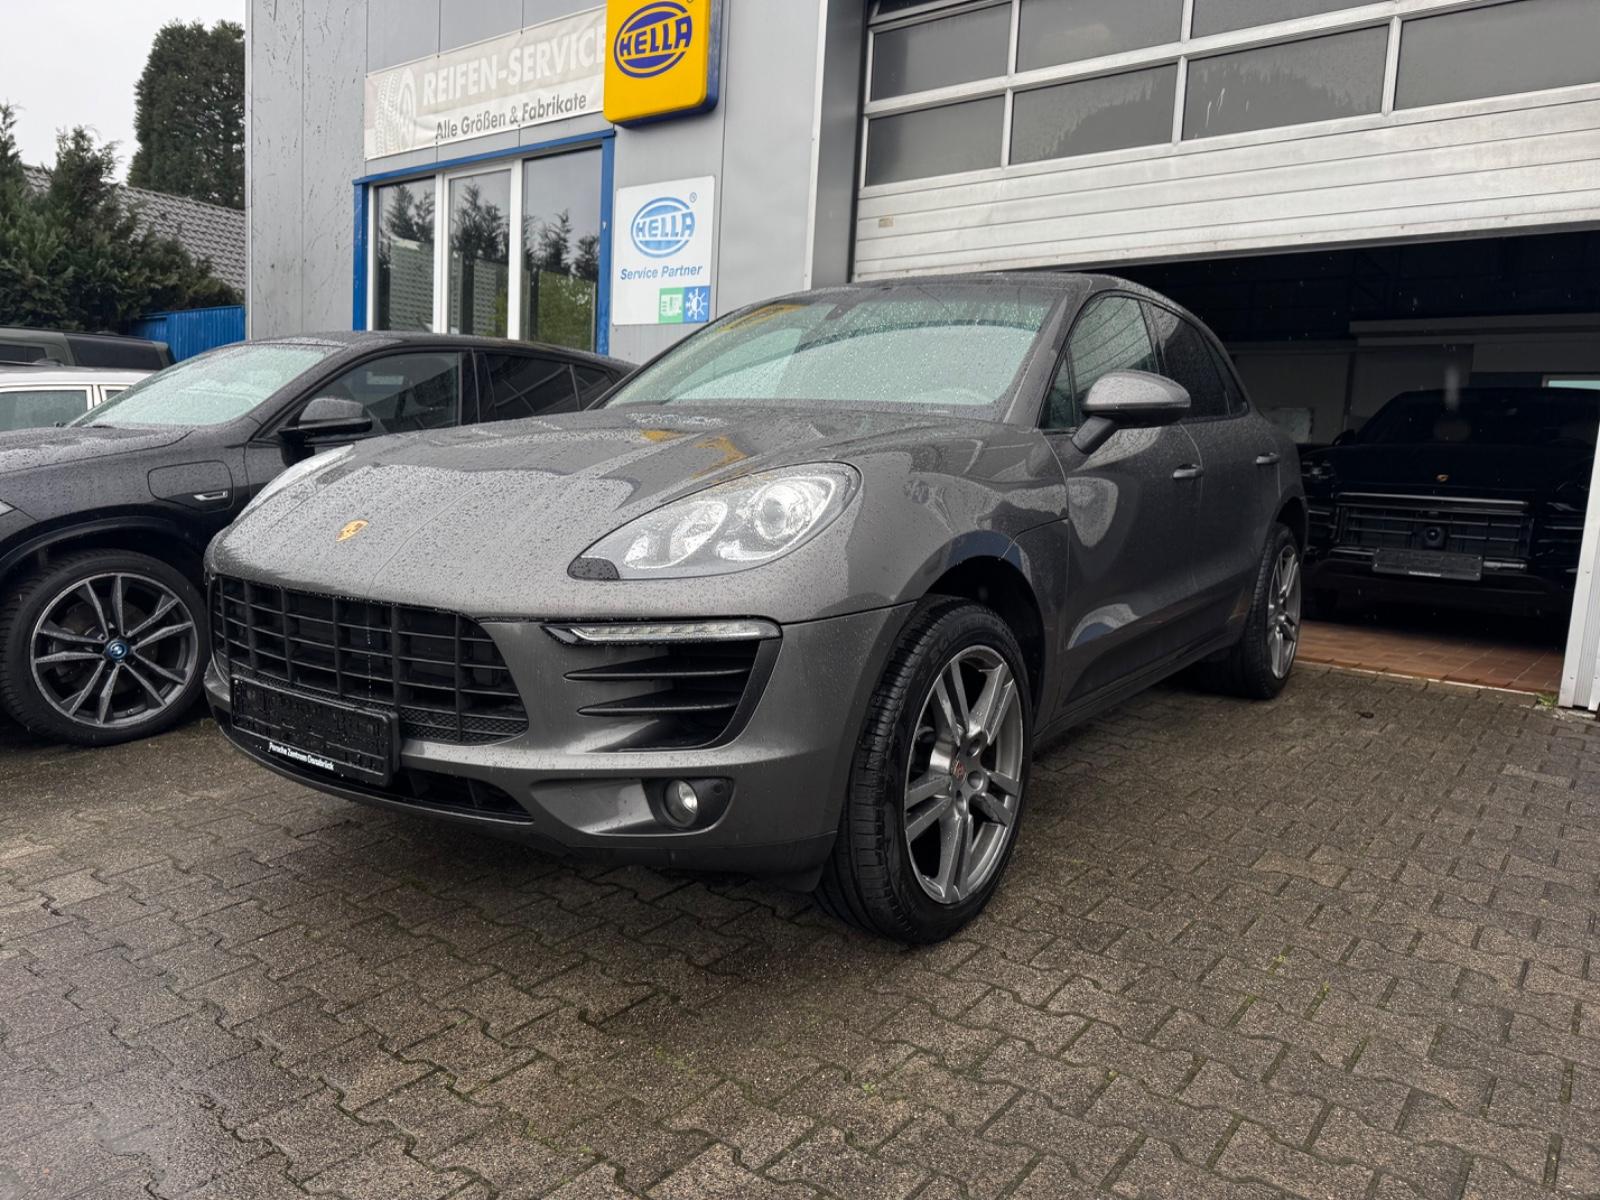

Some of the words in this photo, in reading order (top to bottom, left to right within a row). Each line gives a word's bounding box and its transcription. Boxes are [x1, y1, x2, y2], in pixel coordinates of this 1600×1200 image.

[619, 18, 692, 57] HELLA
[436, 122, 458, 140] Alle
[461, 110, 506, 136] Größen
[509, 108, 519, 124] &
[522, 94, 587, 122] Fabrikate
[635, 212, 695, 237] HELLA
[620, 268, 659, 281] Service
[661, 265, 703, 278] Partner
